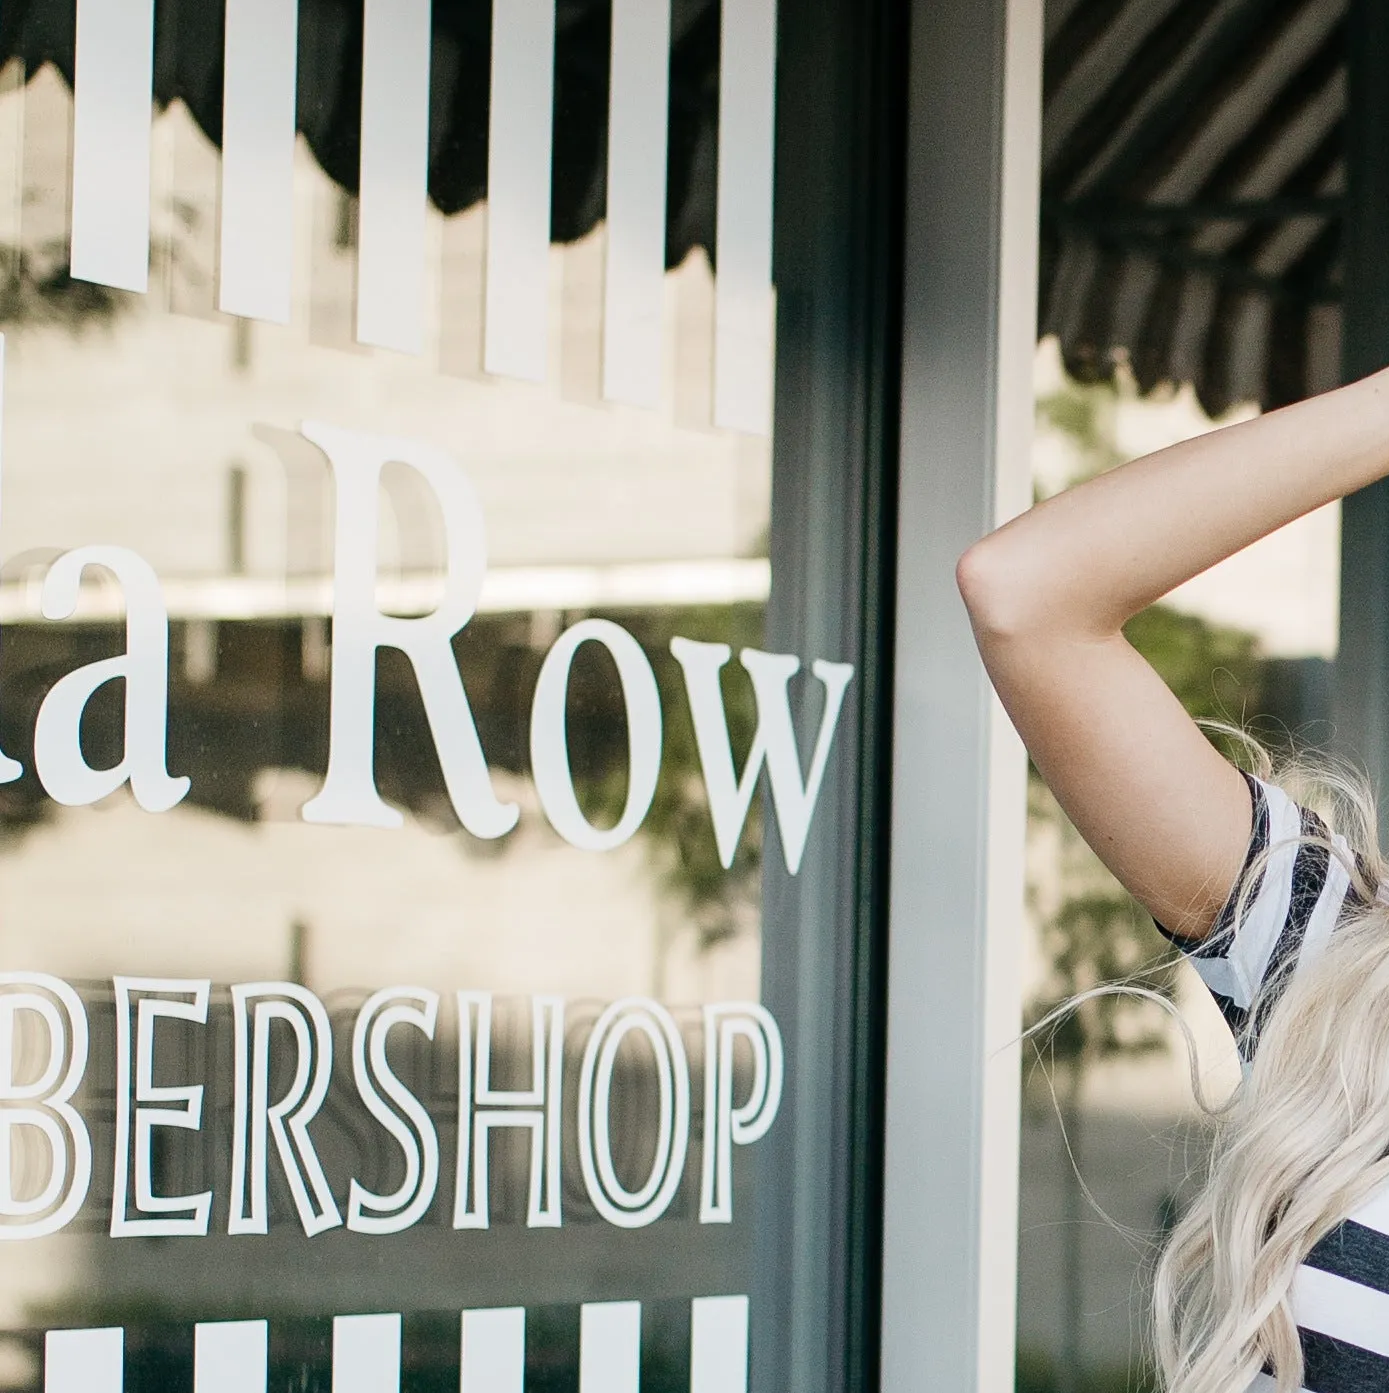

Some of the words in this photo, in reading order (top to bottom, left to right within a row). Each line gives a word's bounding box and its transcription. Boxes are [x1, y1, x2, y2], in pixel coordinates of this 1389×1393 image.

[0, 498, 192, 812] a
[302, 419, 854, 875] Row
[0, 970, 784, 1240] BERSHOP
